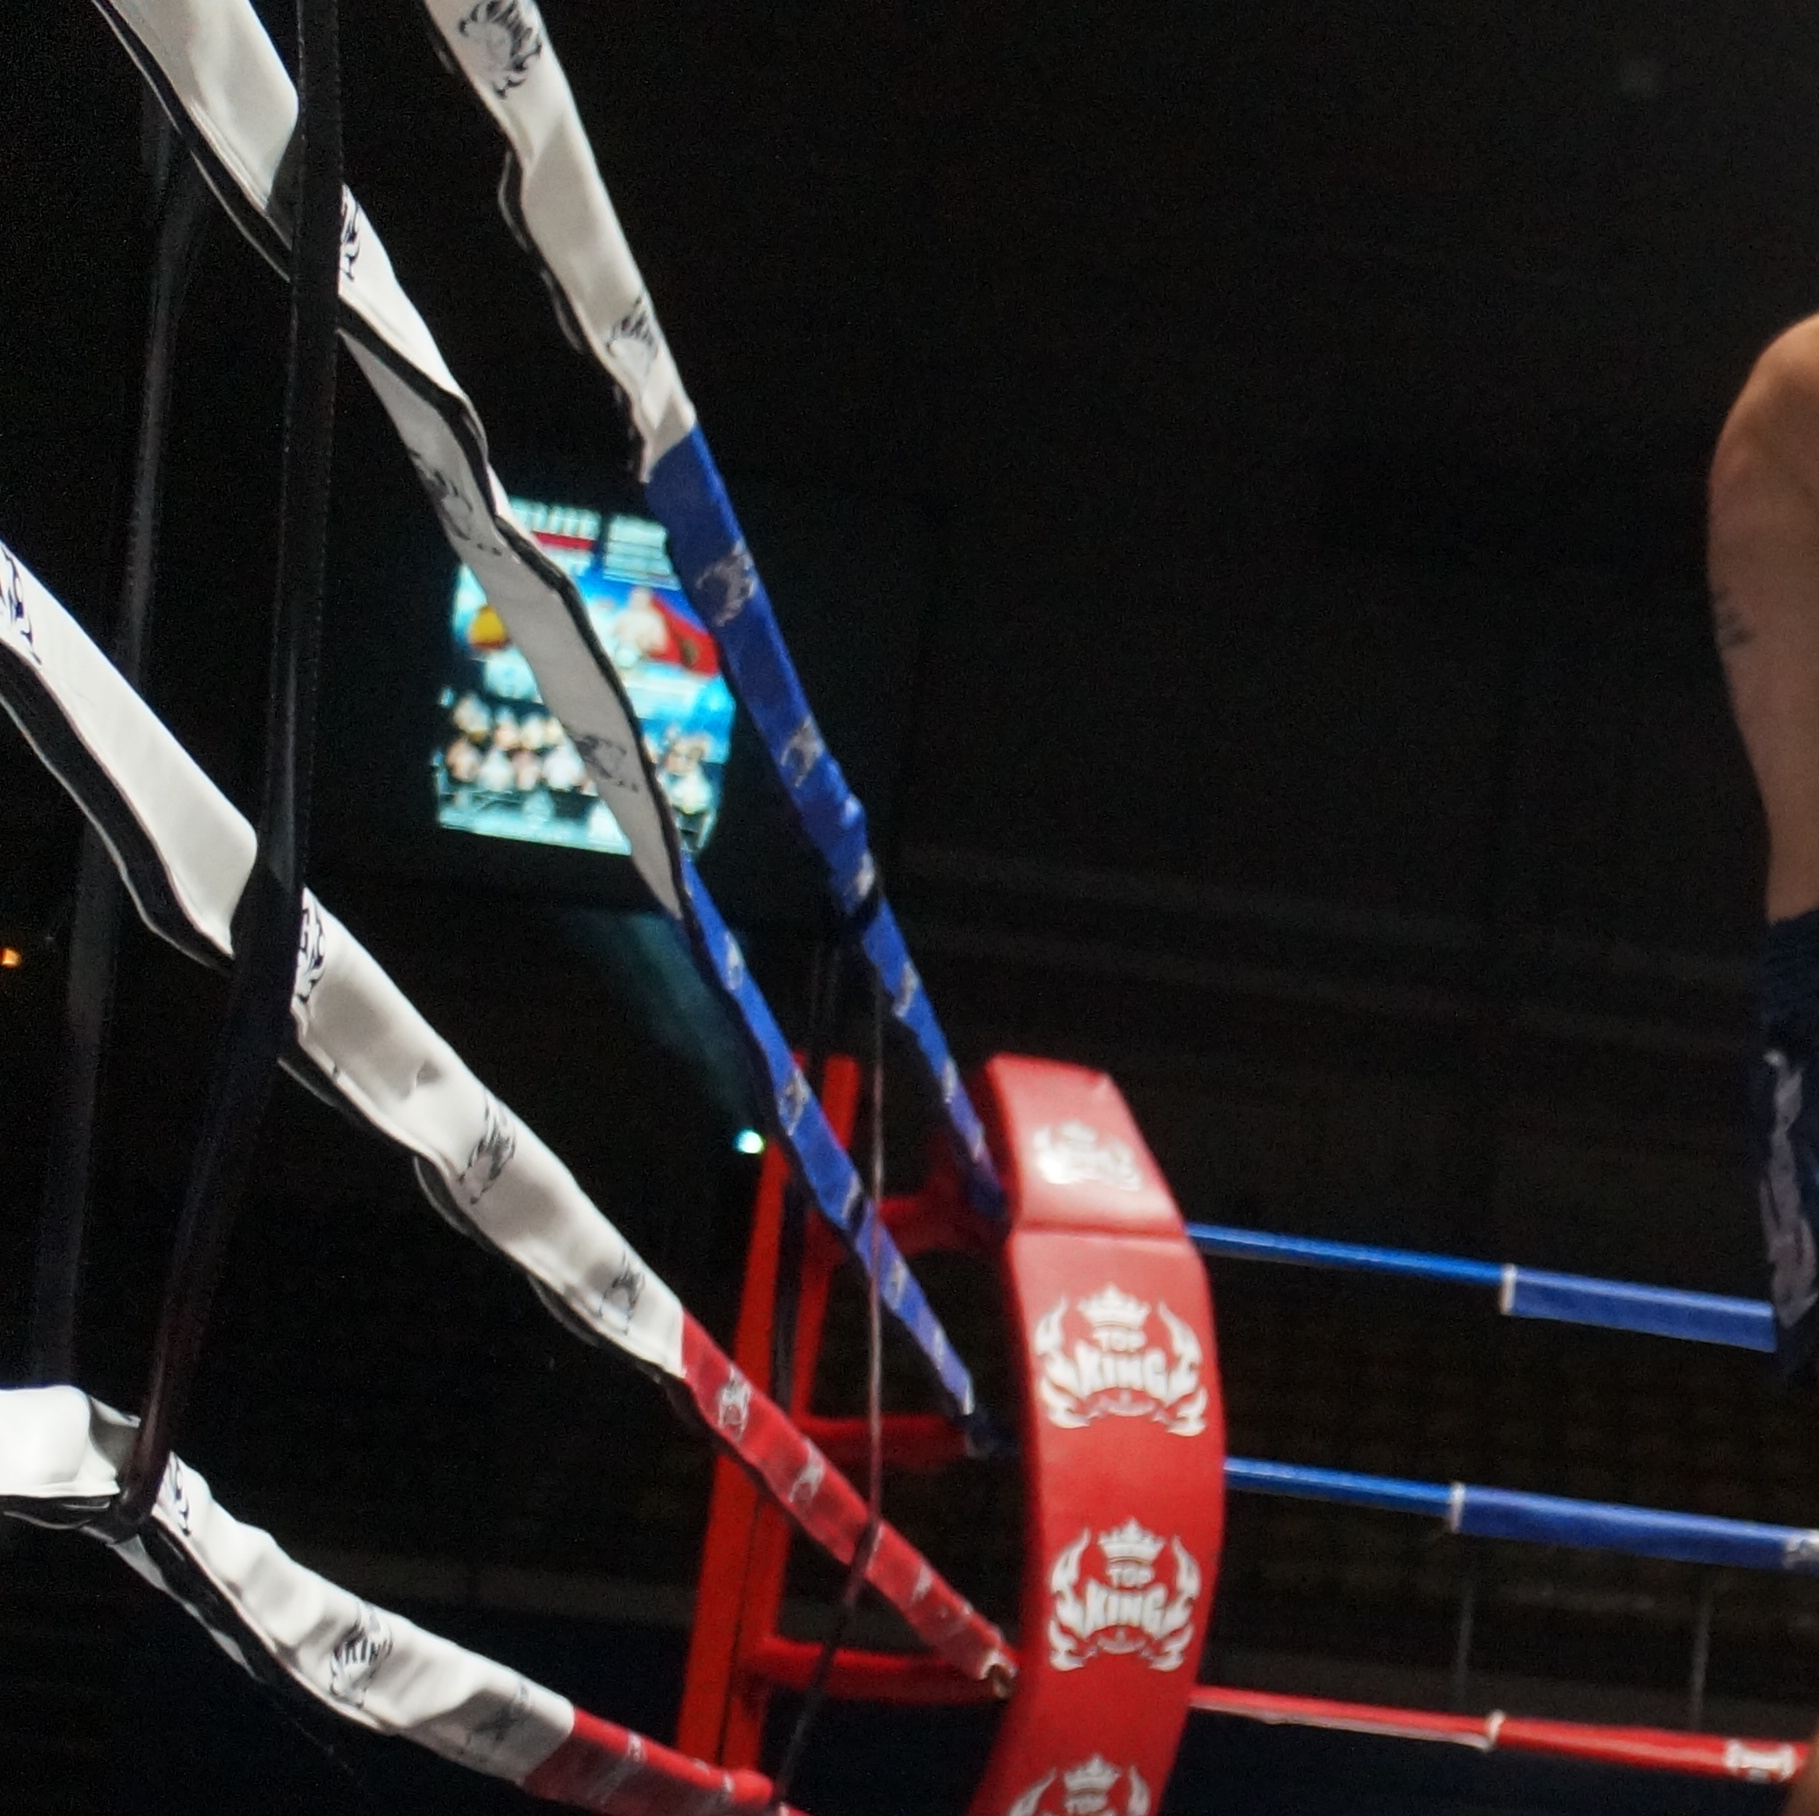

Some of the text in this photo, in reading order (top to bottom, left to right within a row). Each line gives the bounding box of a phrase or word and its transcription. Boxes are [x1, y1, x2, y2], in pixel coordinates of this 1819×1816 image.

[1092, 1329, 1147, 1352] TOP
[1074, 1340, 1169, 1408] KING
[1107, 1566, 1155, 1589] TOP
[1084, 1577, 1168, 1641] KING
